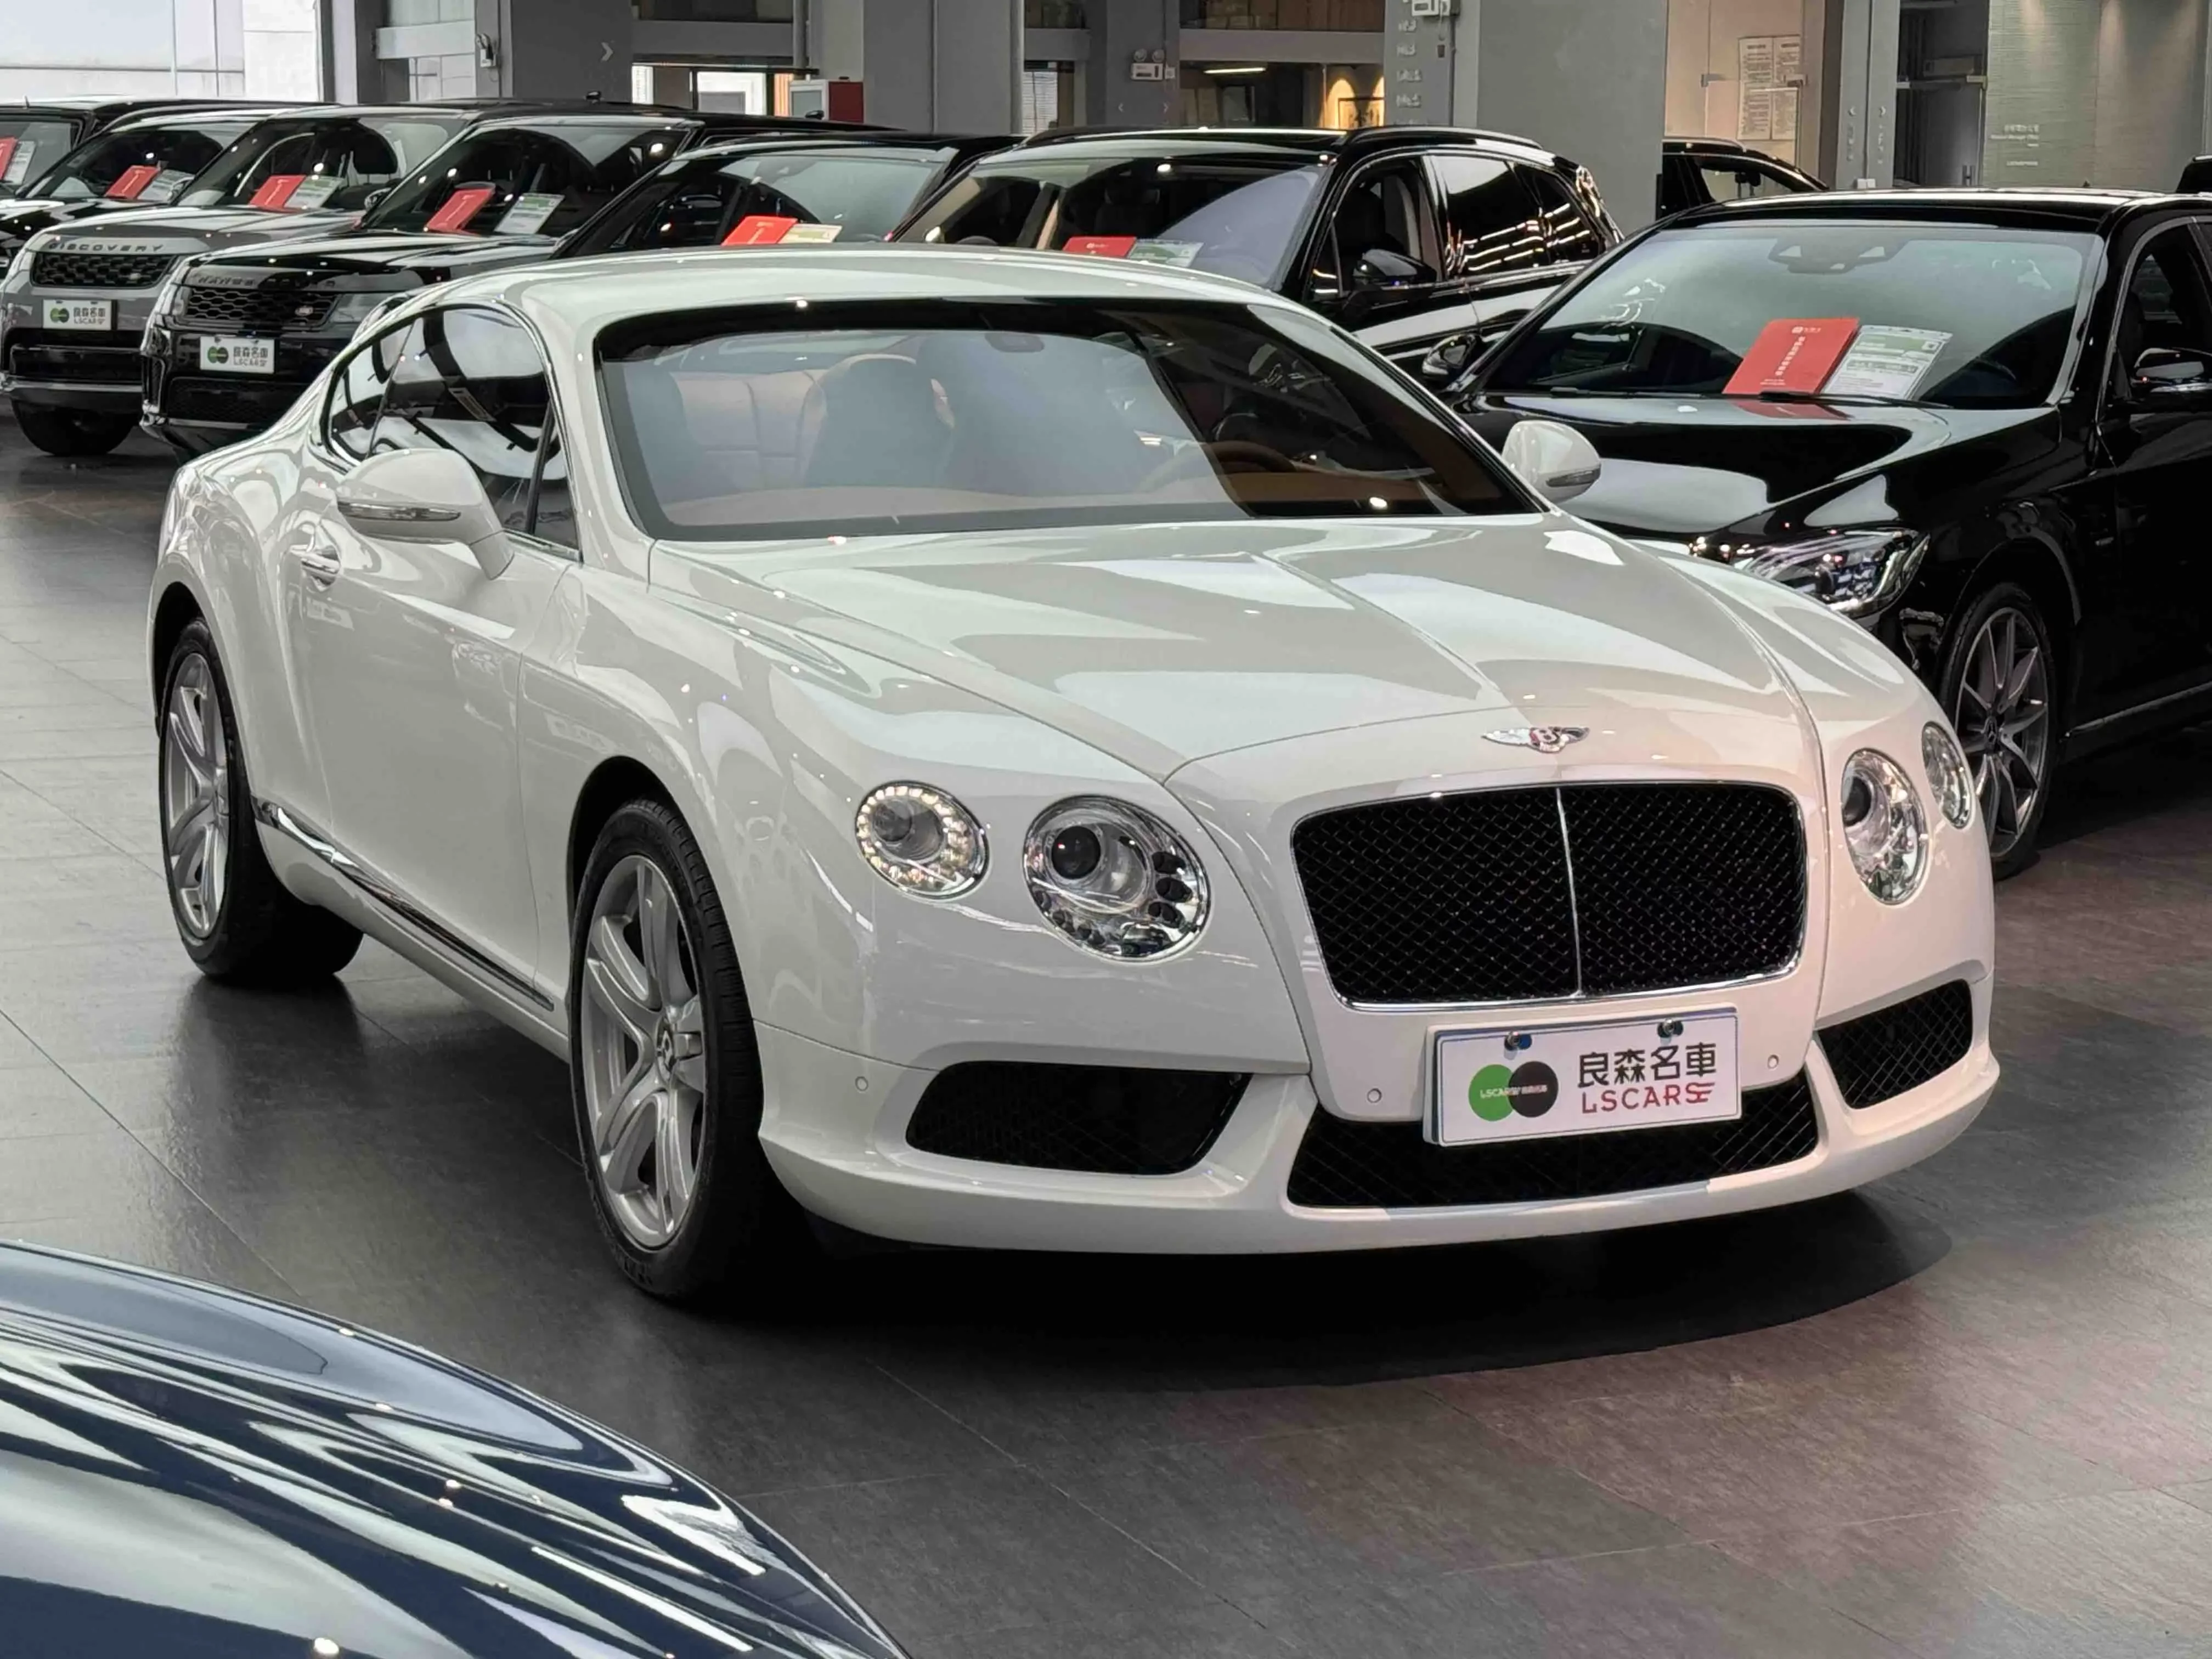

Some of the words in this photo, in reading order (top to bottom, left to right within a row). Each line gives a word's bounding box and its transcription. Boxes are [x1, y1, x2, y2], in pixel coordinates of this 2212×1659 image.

[1578, 1042, 1717, 1088] 良森名車
[1582, 1082, 1716, 1114] LSCARS
